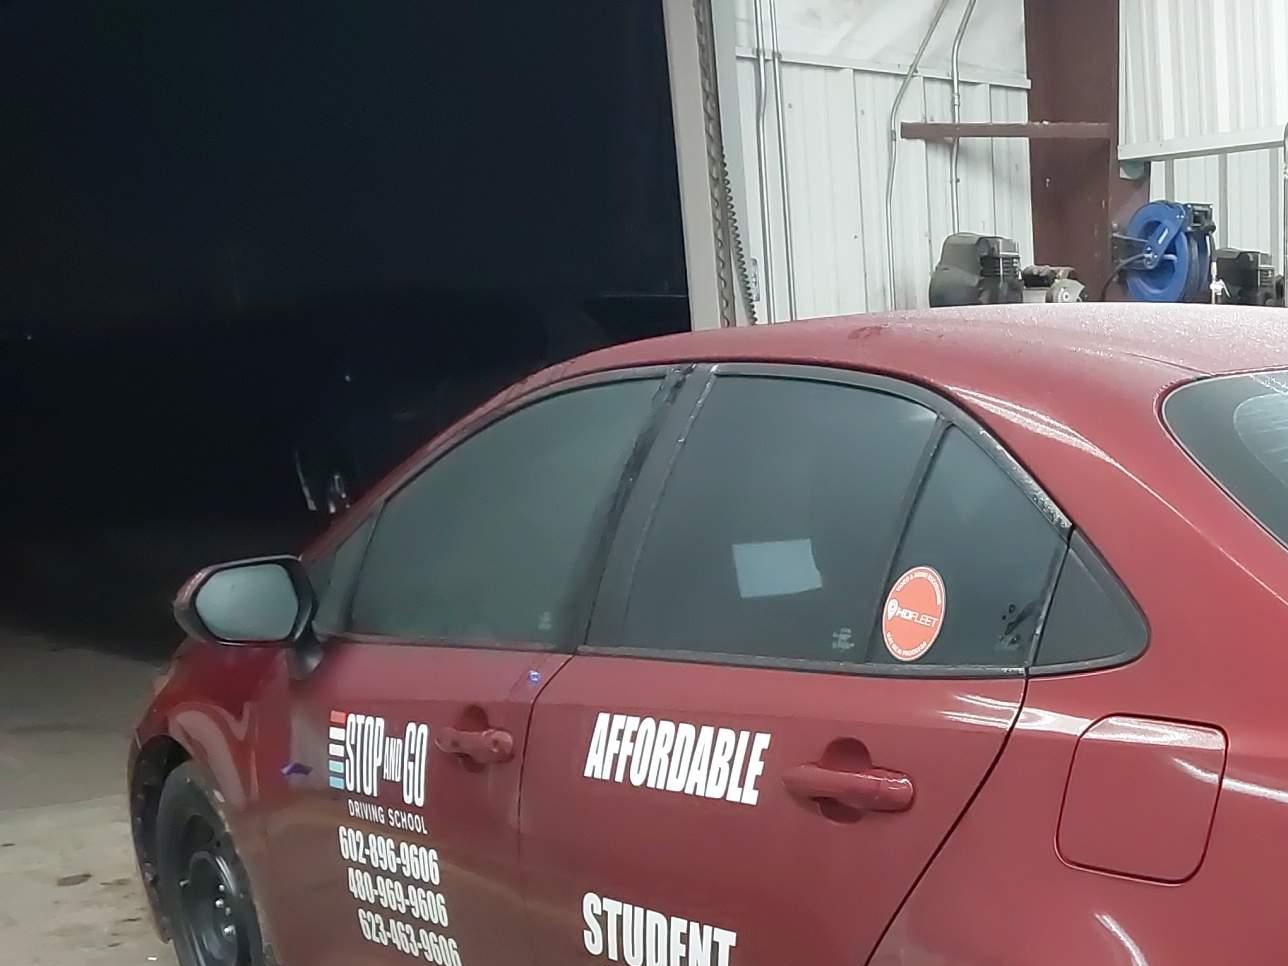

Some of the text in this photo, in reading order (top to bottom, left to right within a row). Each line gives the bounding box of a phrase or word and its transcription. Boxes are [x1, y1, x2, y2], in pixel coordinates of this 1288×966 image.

[345, 713, 428, 807] STOP AND GO
[583, 712, 772, 806] AFFORDABLE
[348, 799, 428, 834] DRIVING SCHOOL
[338, 825, 440, 885] 602-896-9606
[348, 867, 448, 927] 480-969-9606
